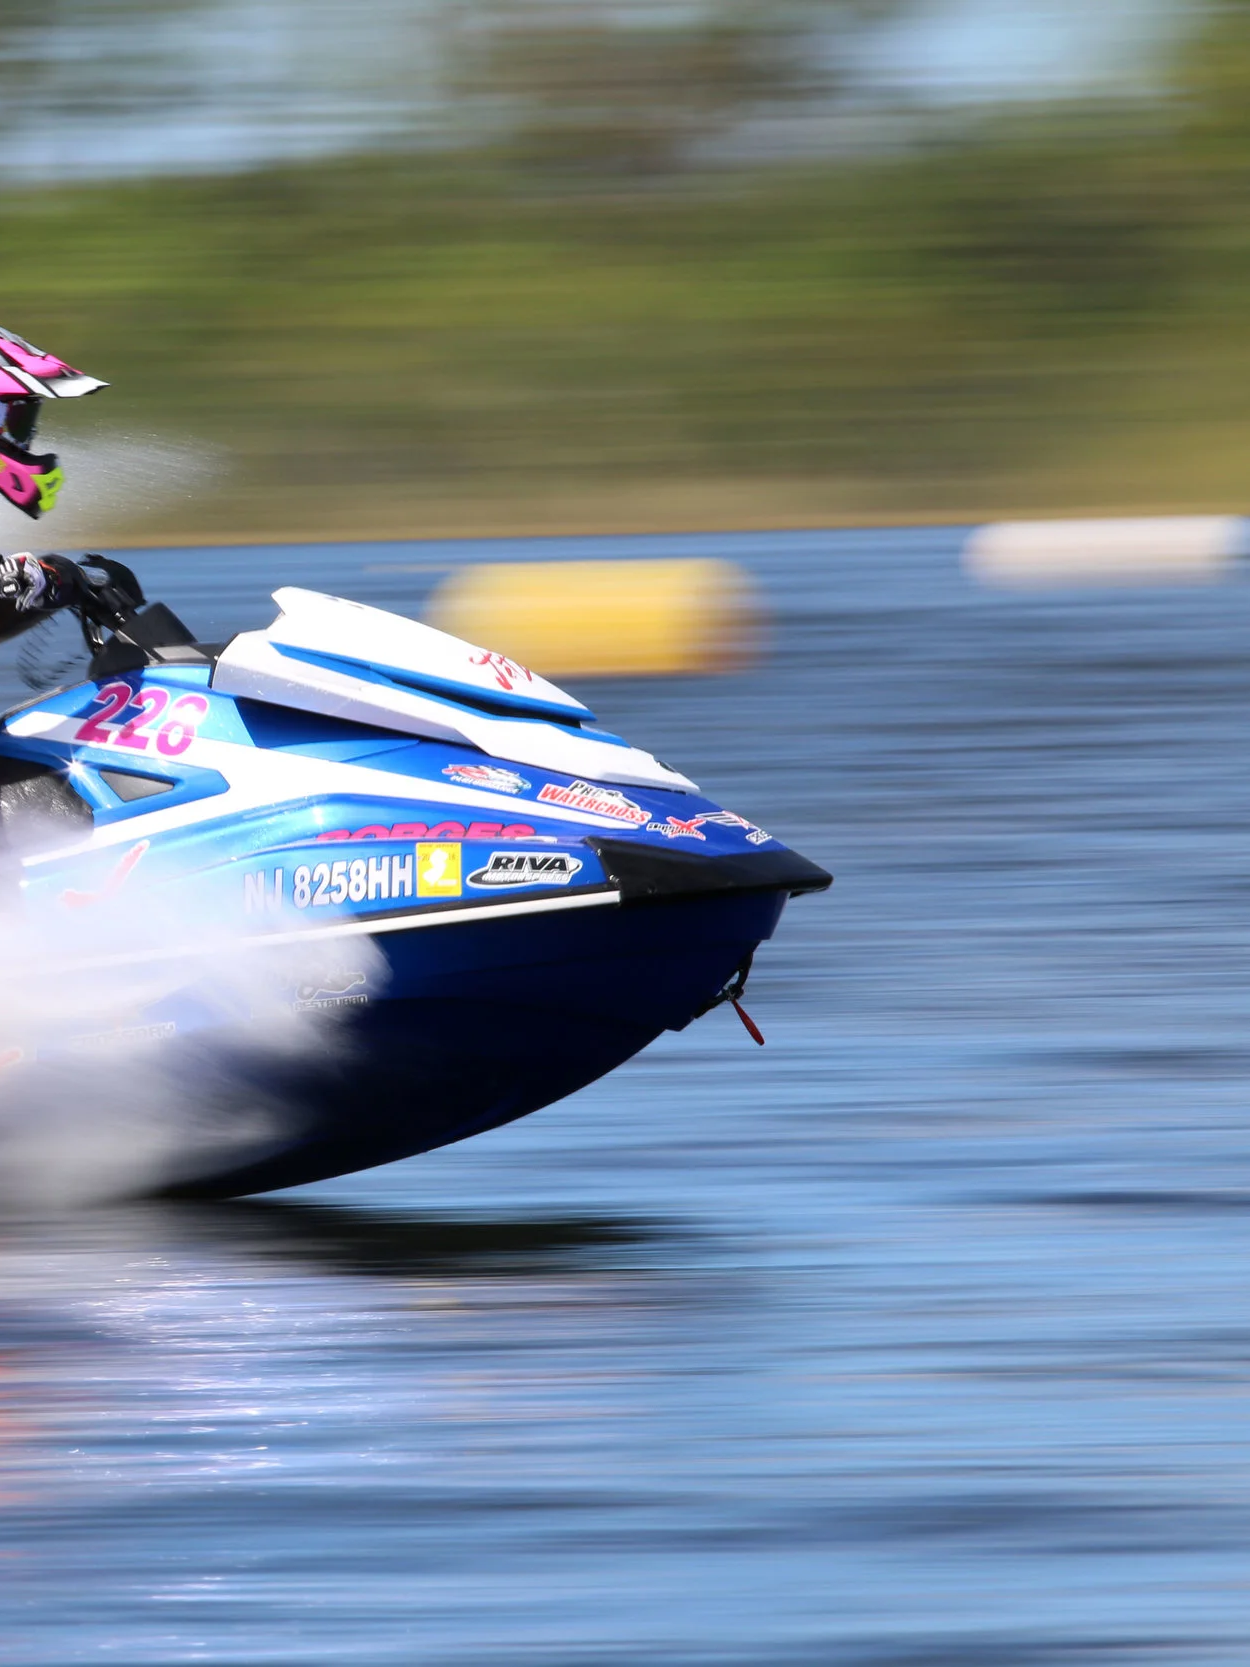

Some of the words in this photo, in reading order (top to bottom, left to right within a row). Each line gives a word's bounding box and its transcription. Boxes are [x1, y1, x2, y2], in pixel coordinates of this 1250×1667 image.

[74, 681, 210, 756] 228
[539, 784, 650, 823] WATERCROSS
[243, 867, 283, 914] NJ
[293, 854, 413, 909] 8258HH
[490, 855, 569, 872] RIVA
